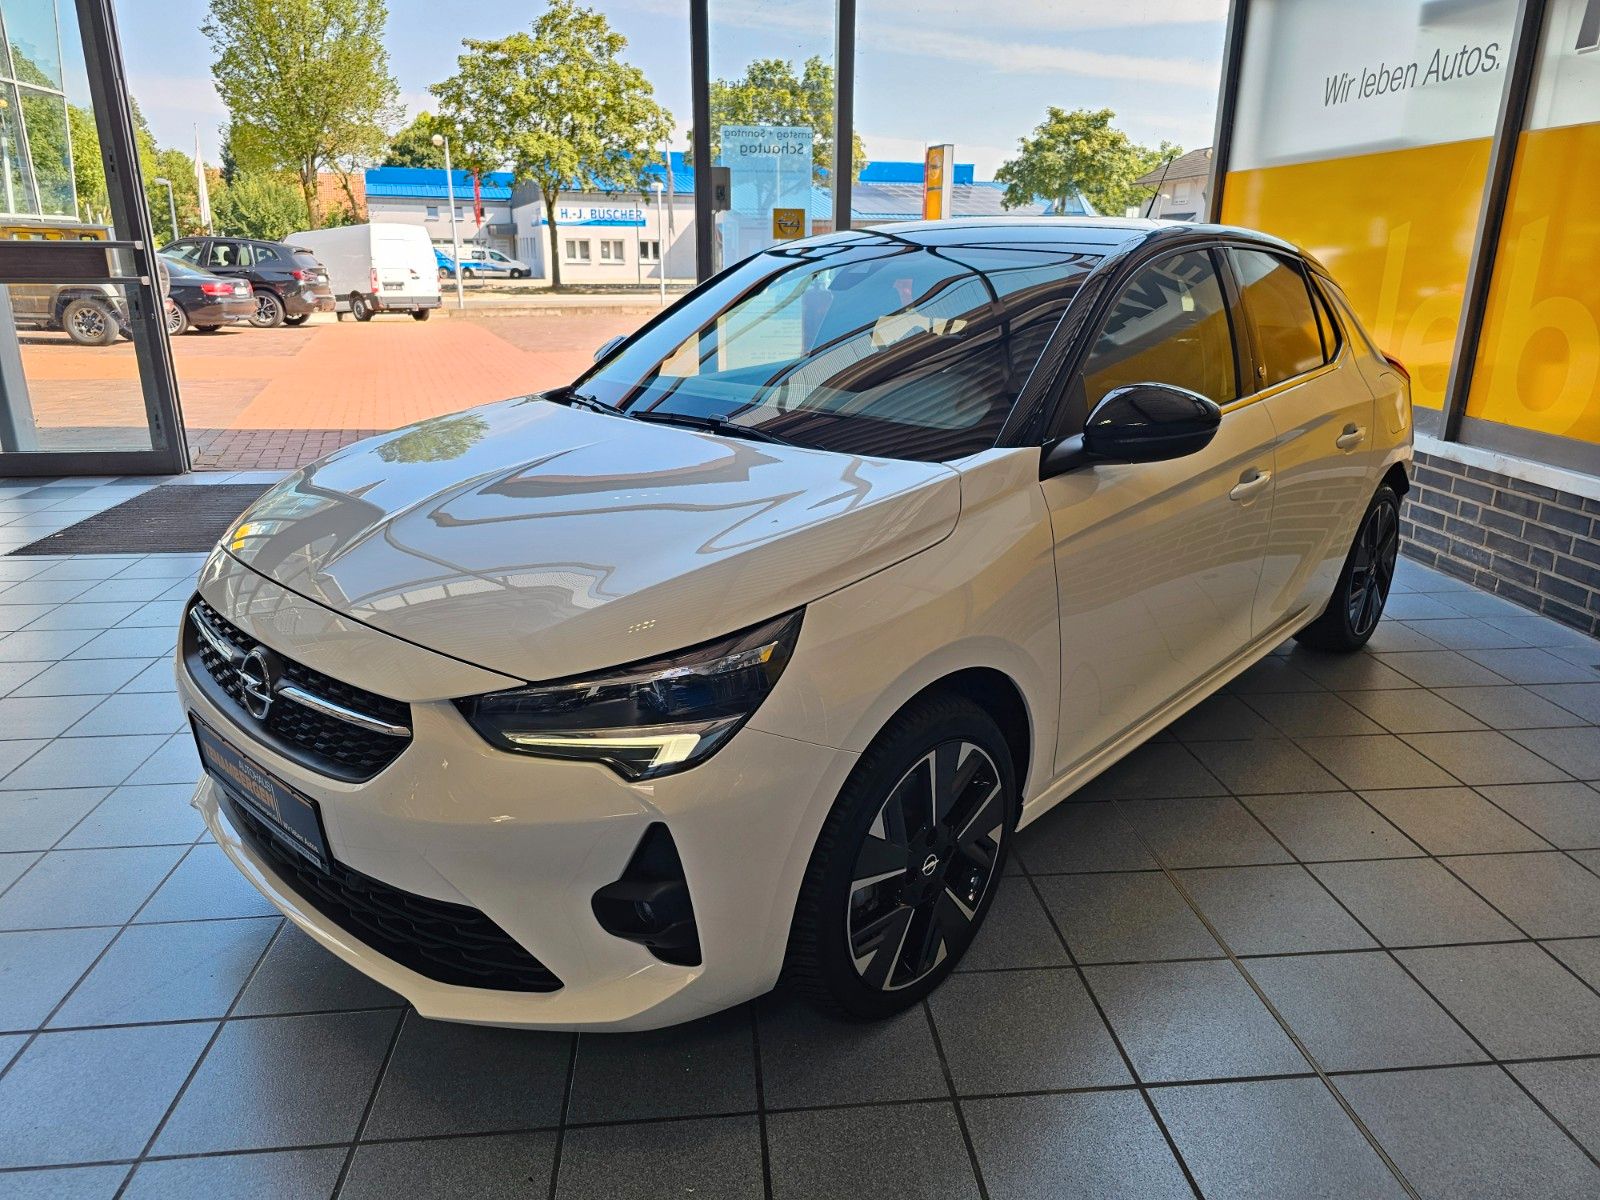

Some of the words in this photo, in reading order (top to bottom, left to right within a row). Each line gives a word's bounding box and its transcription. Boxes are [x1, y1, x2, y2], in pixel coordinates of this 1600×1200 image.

[1325, 73, 1356, 107] Wir
[1358, 63, 1418, 99] leben
[1422, 43, 1500, 86] Autos.
